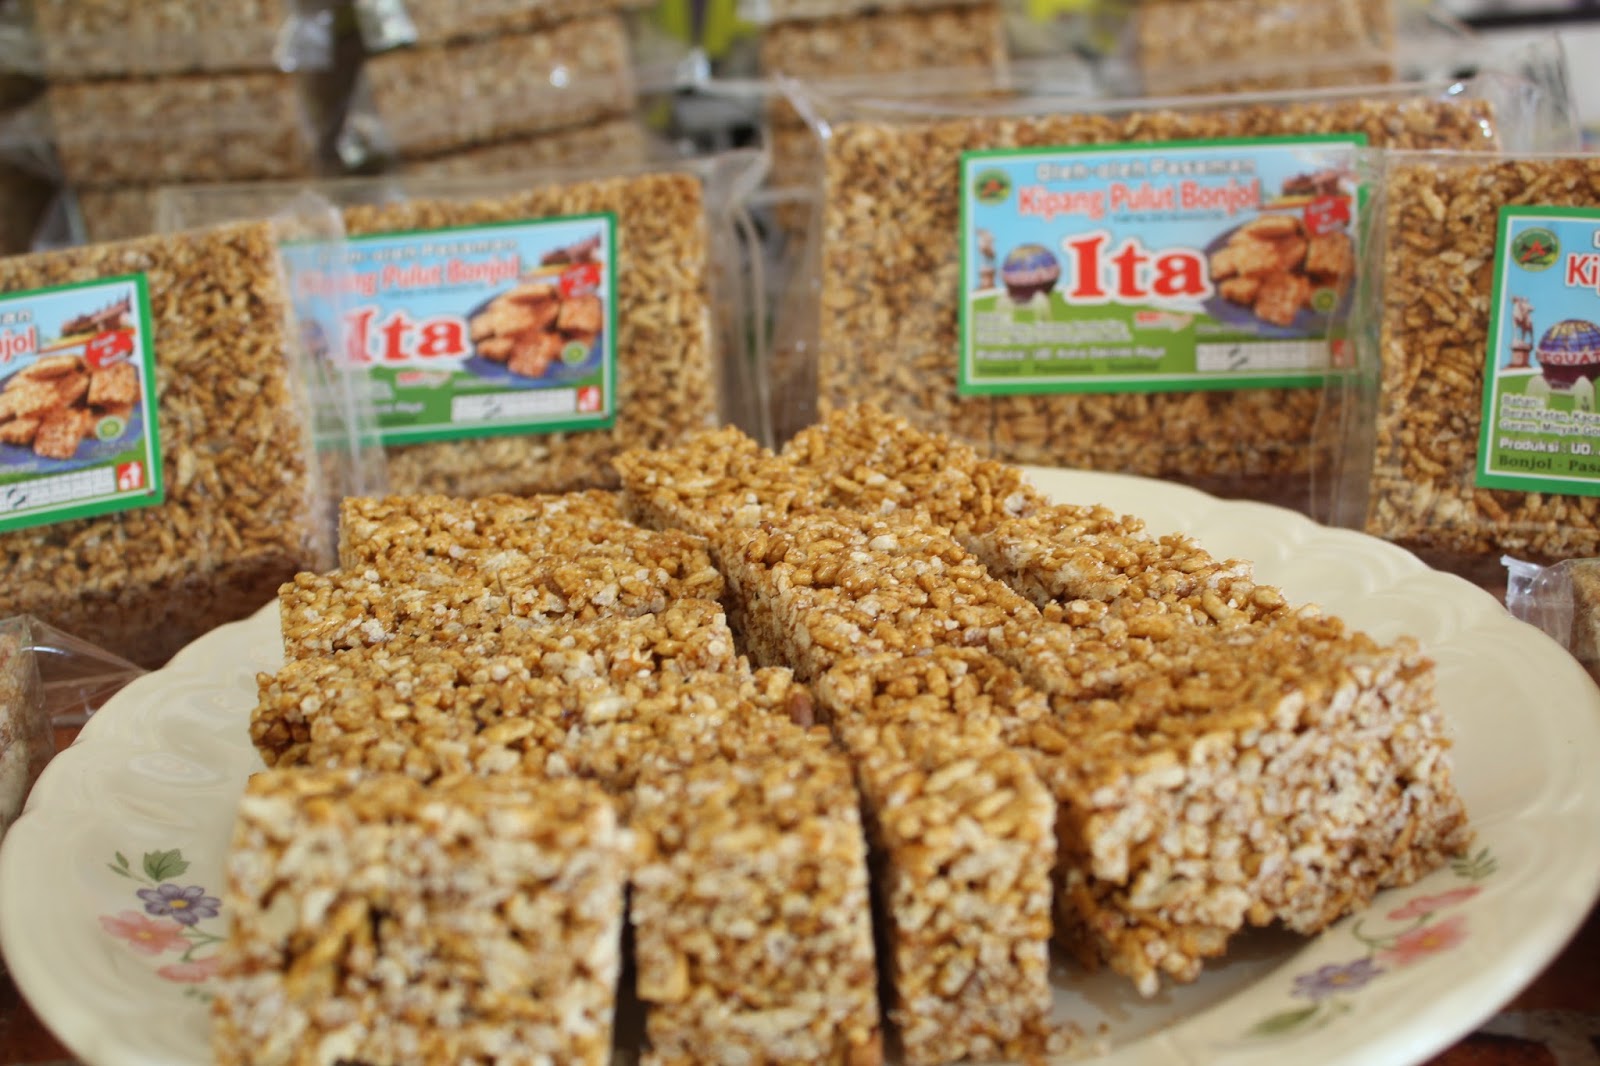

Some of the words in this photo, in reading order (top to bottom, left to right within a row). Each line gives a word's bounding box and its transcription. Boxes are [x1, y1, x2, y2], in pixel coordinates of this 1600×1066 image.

[1017, 185, 1105, 221] Kipang
[1109, 181, 1176, 212] Pulut
[1180, 178, 1261, 216] Bonjol
[382, 261, 442, 288] Pulut
[446, 253, 520, 285] Bonjol
[1542, 422, 1579, 436] Minyak
[1500, 437, 1560, 453] Produksi
[1499, 454, 1552, 471] Bonjol
